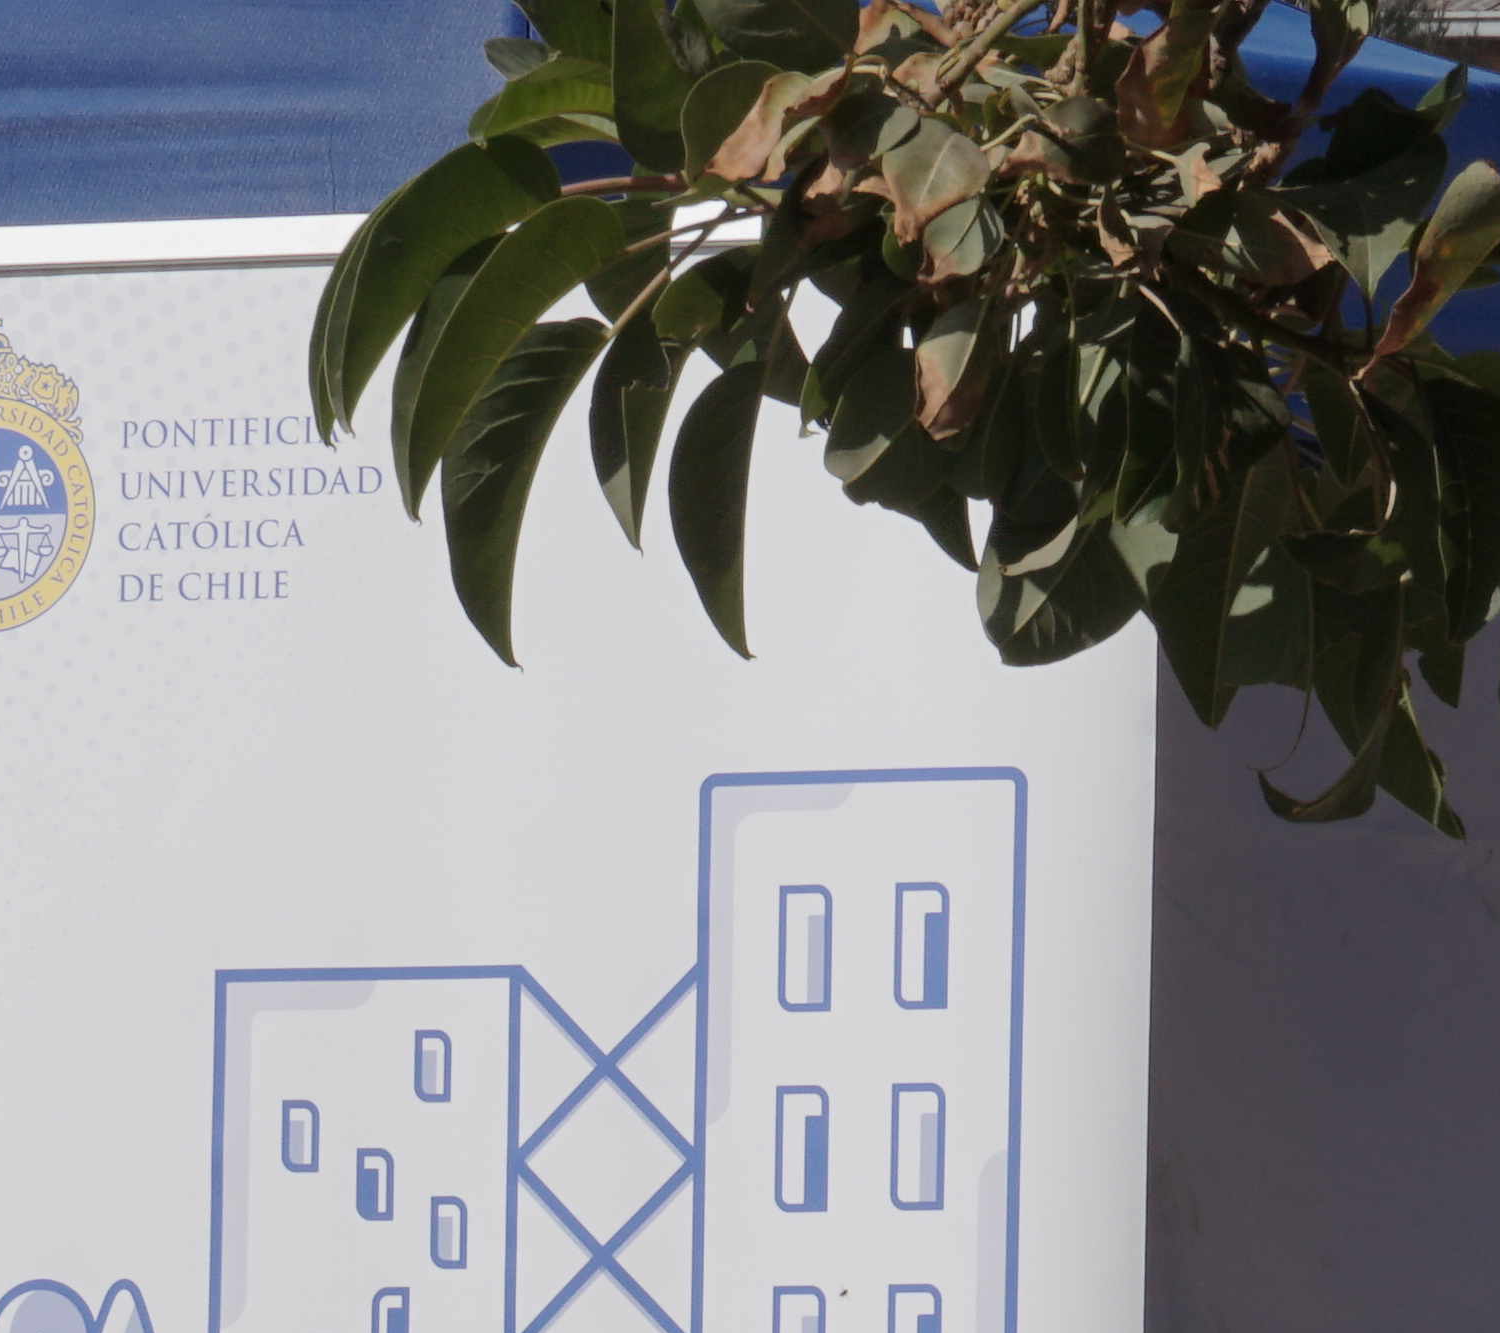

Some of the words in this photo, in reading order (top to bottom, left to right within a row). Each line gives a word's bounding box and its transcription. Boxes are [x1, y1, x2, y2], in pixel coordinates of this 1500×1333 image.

[120, 465, 384, 500] UNIVERSIDAD
[118, 513, 306, 551] CATÓLICA
[119, 573, 164, 602] DE
[178, 570, 290, 602] CHILE
